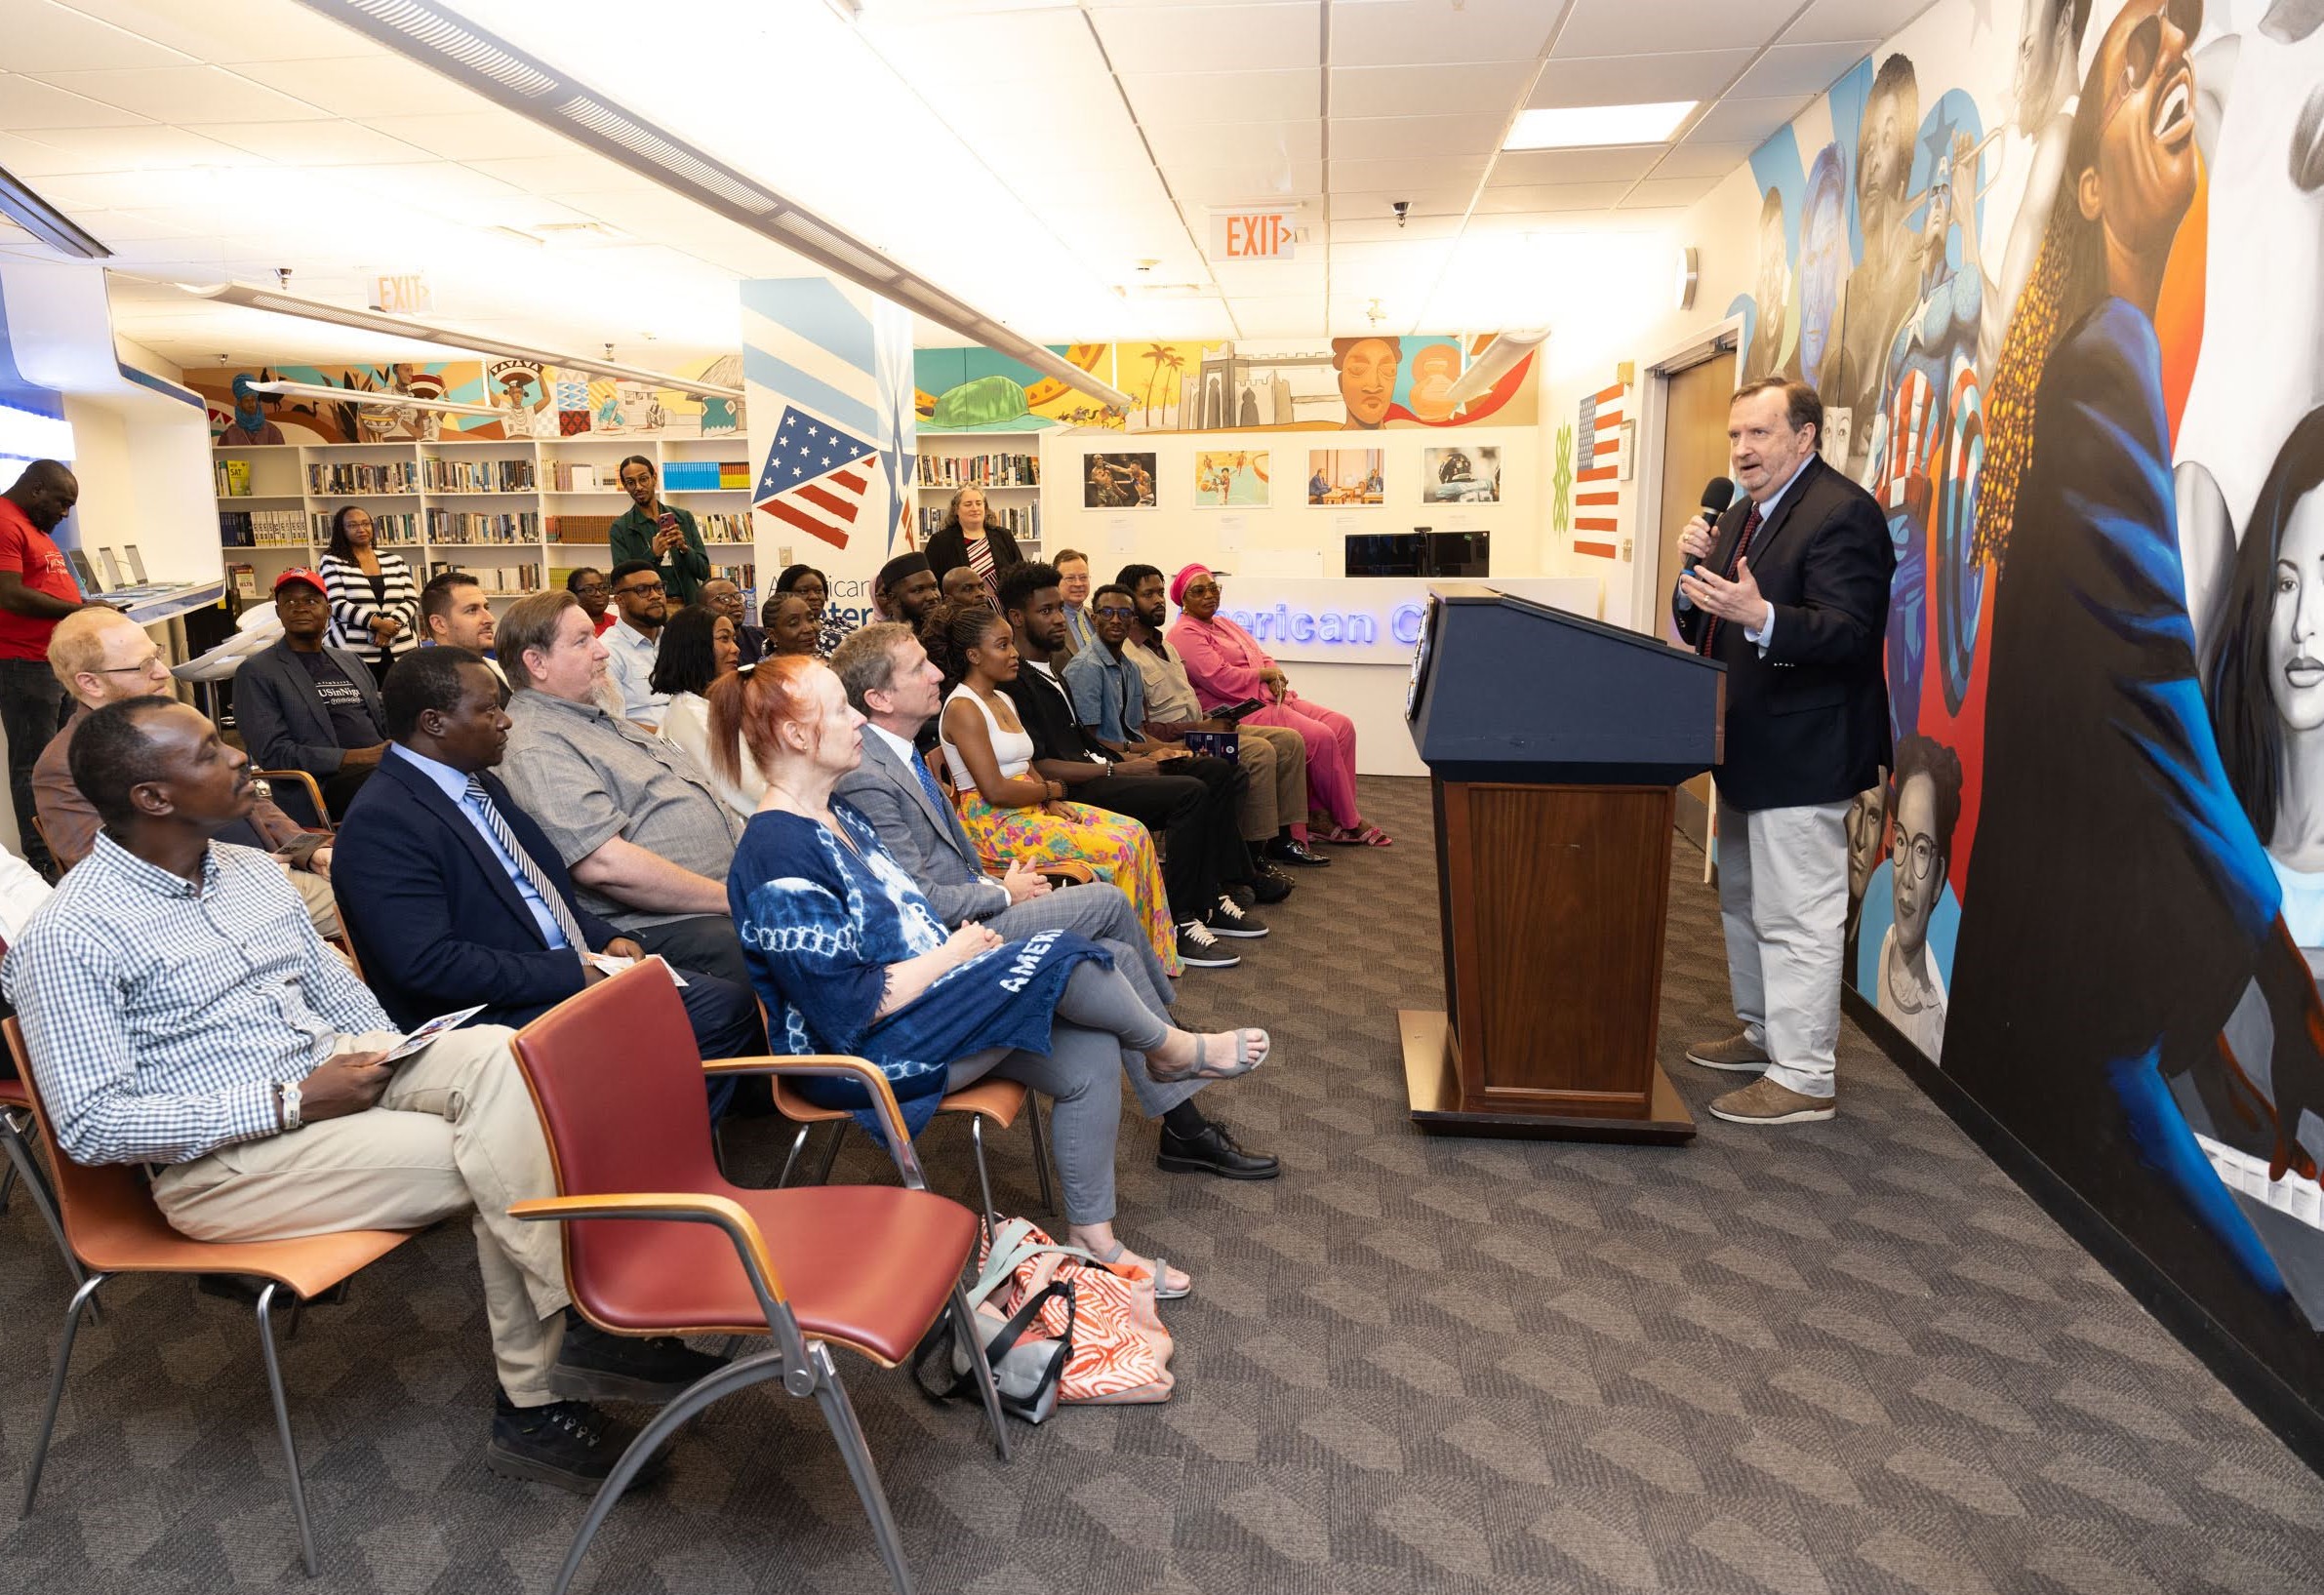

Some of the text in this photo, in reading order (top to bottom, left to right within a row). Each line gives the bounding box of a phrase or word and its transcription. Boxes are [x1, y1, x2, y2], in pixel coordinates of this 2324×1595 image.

[1227, 215, 1282, 256] EXIT
[378, 276, 421, 311] EXIT
[821, 602, 873, 625] ter
[1216, 604, 1374, 643] erican
